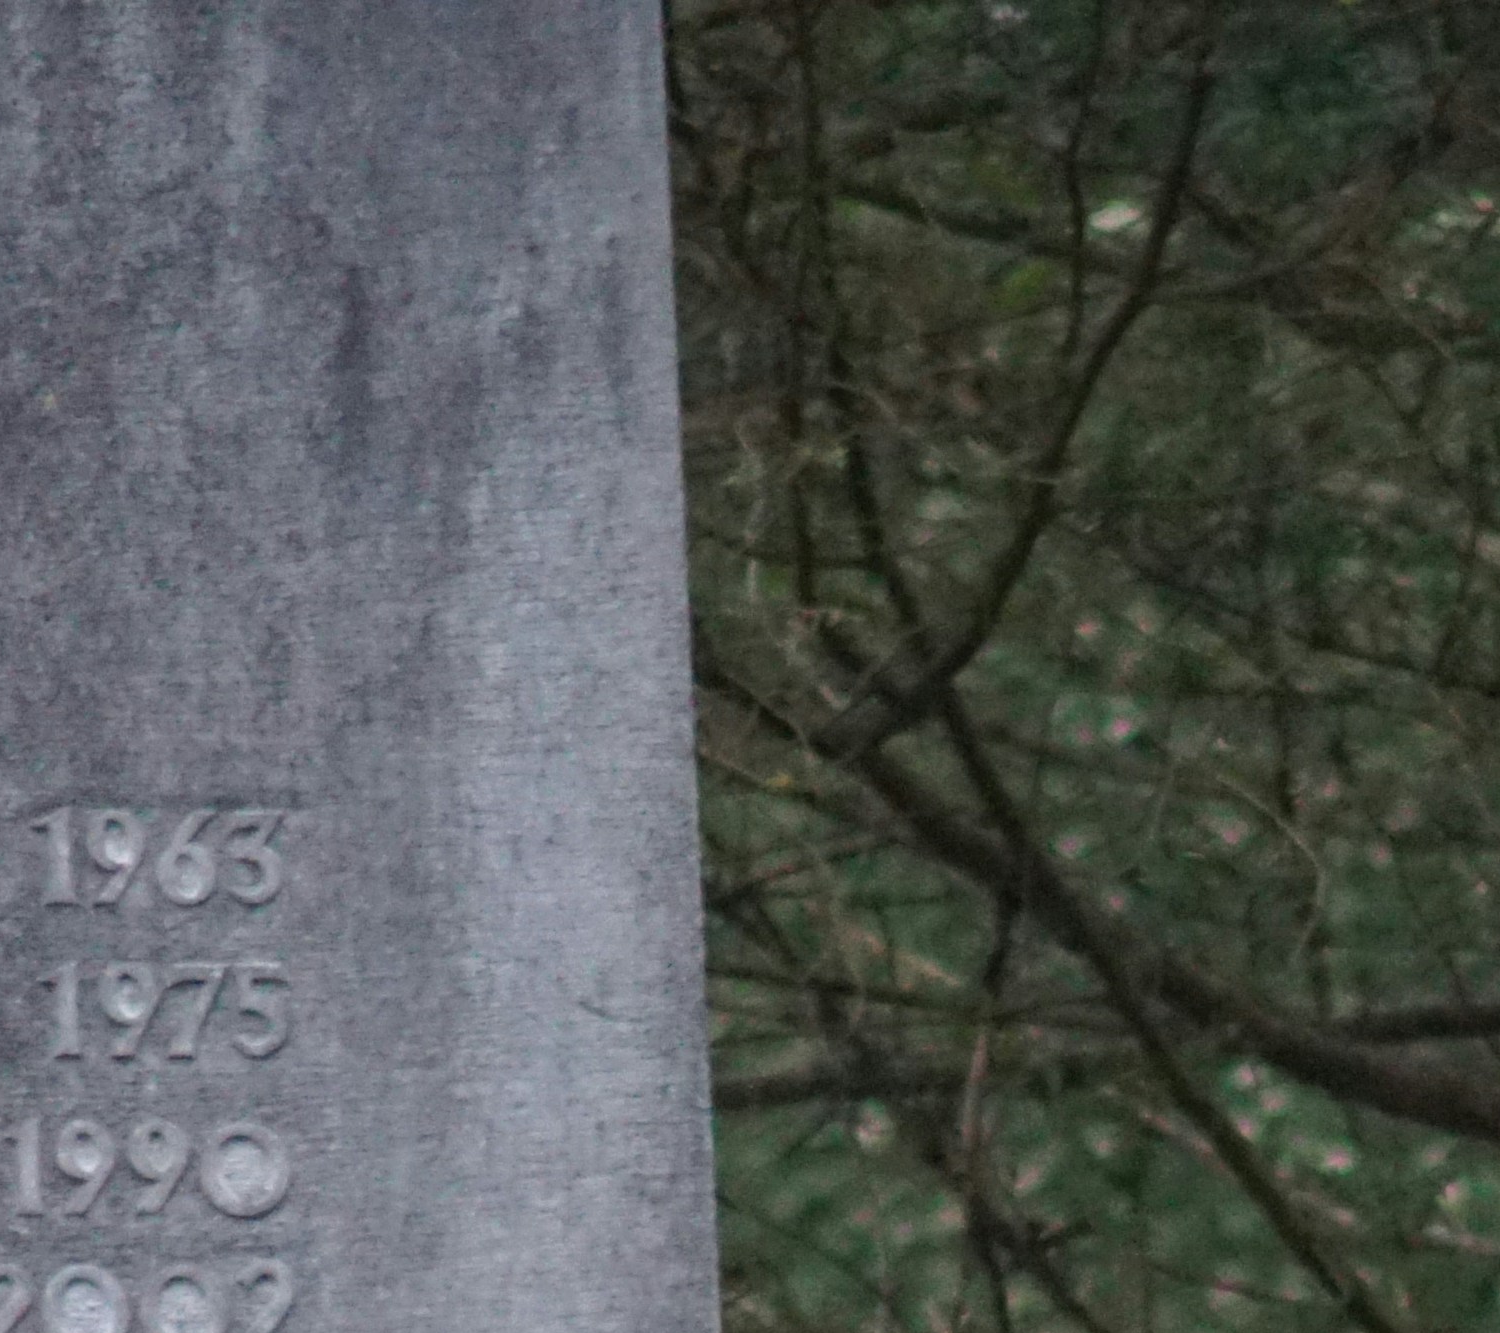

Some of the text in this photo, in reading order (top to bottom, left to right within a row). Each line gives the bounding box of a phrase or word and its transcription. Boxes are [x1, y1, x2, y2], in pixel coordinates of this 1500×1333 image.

[30, 806, 286, 908] 1963
[38, 960, 292, 1062] 1975
[3, 1116, 291, 1220] 1990
